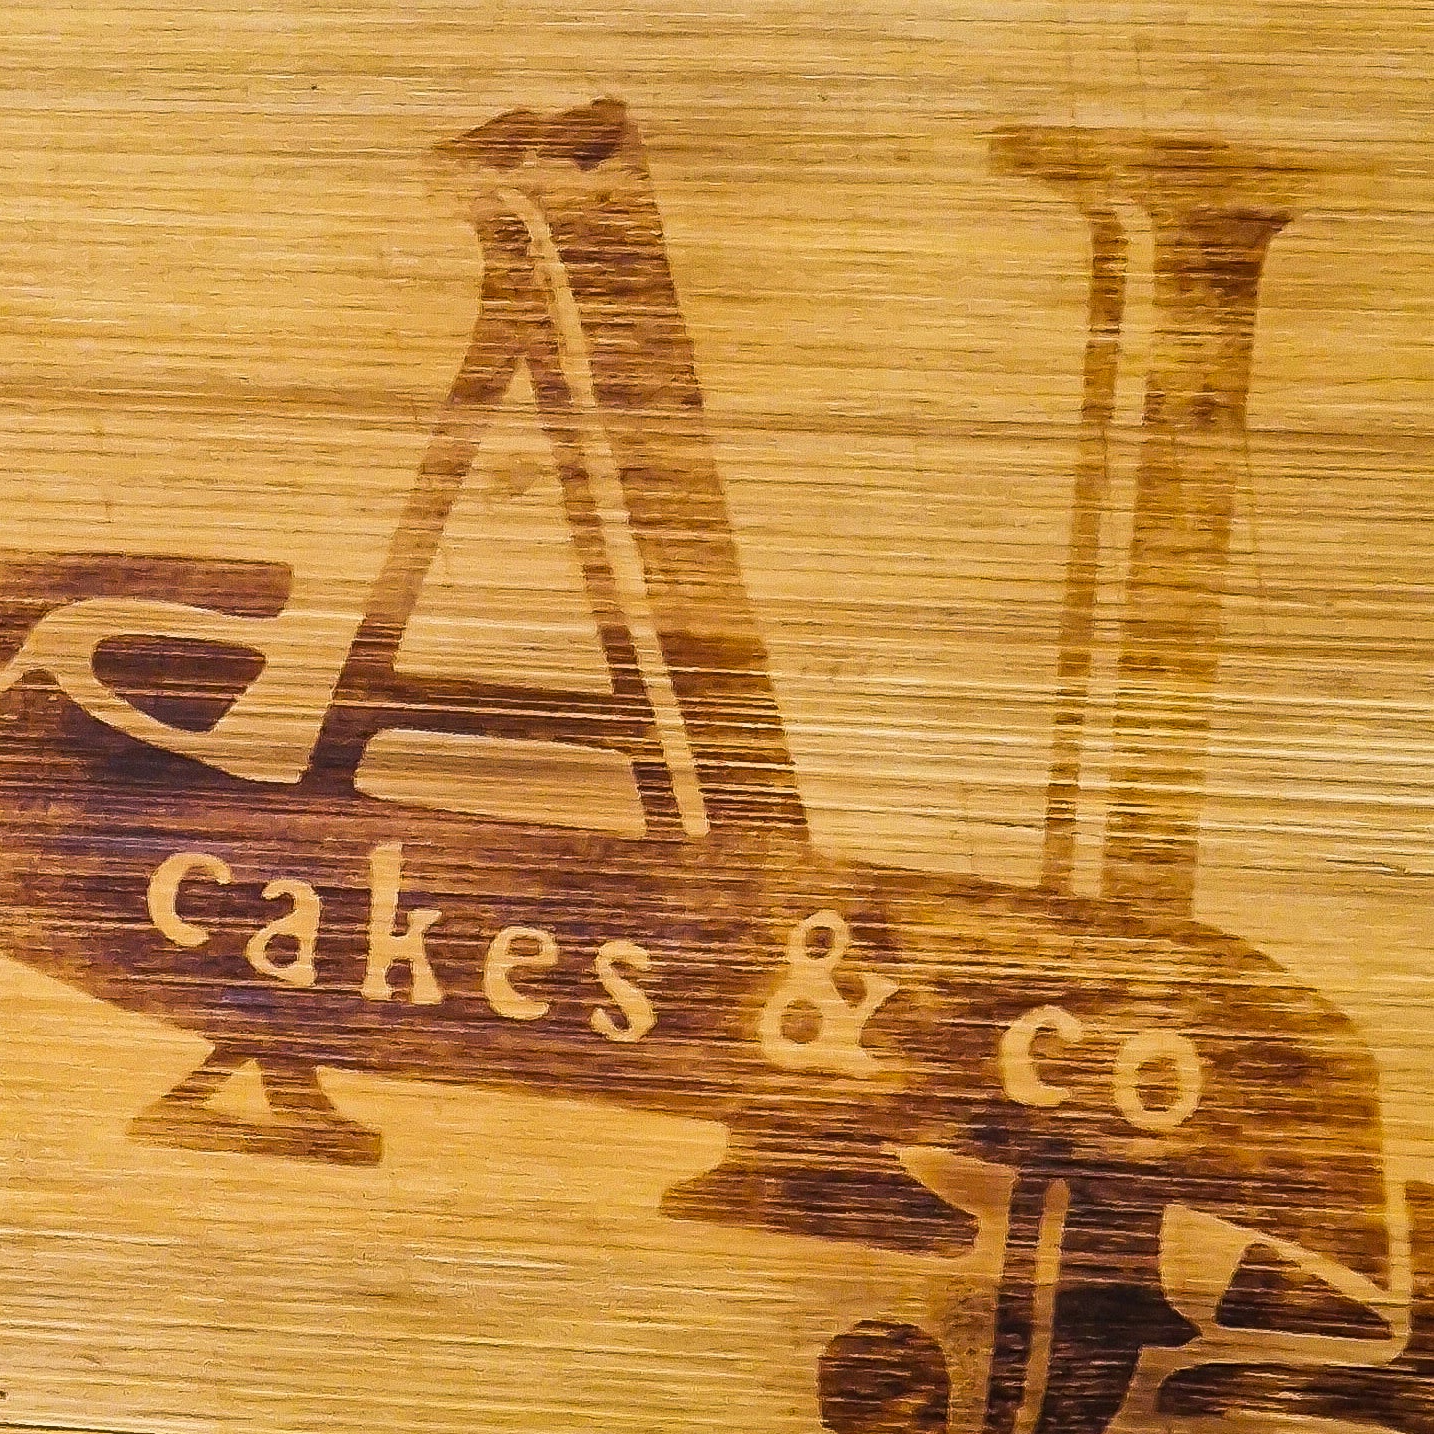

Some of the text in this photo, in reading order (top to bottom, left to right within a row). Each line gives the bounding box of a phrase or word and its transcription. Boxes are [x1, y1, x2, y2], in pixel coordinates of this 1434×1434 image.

[148, 842, 1205, 1129] cakes & co
